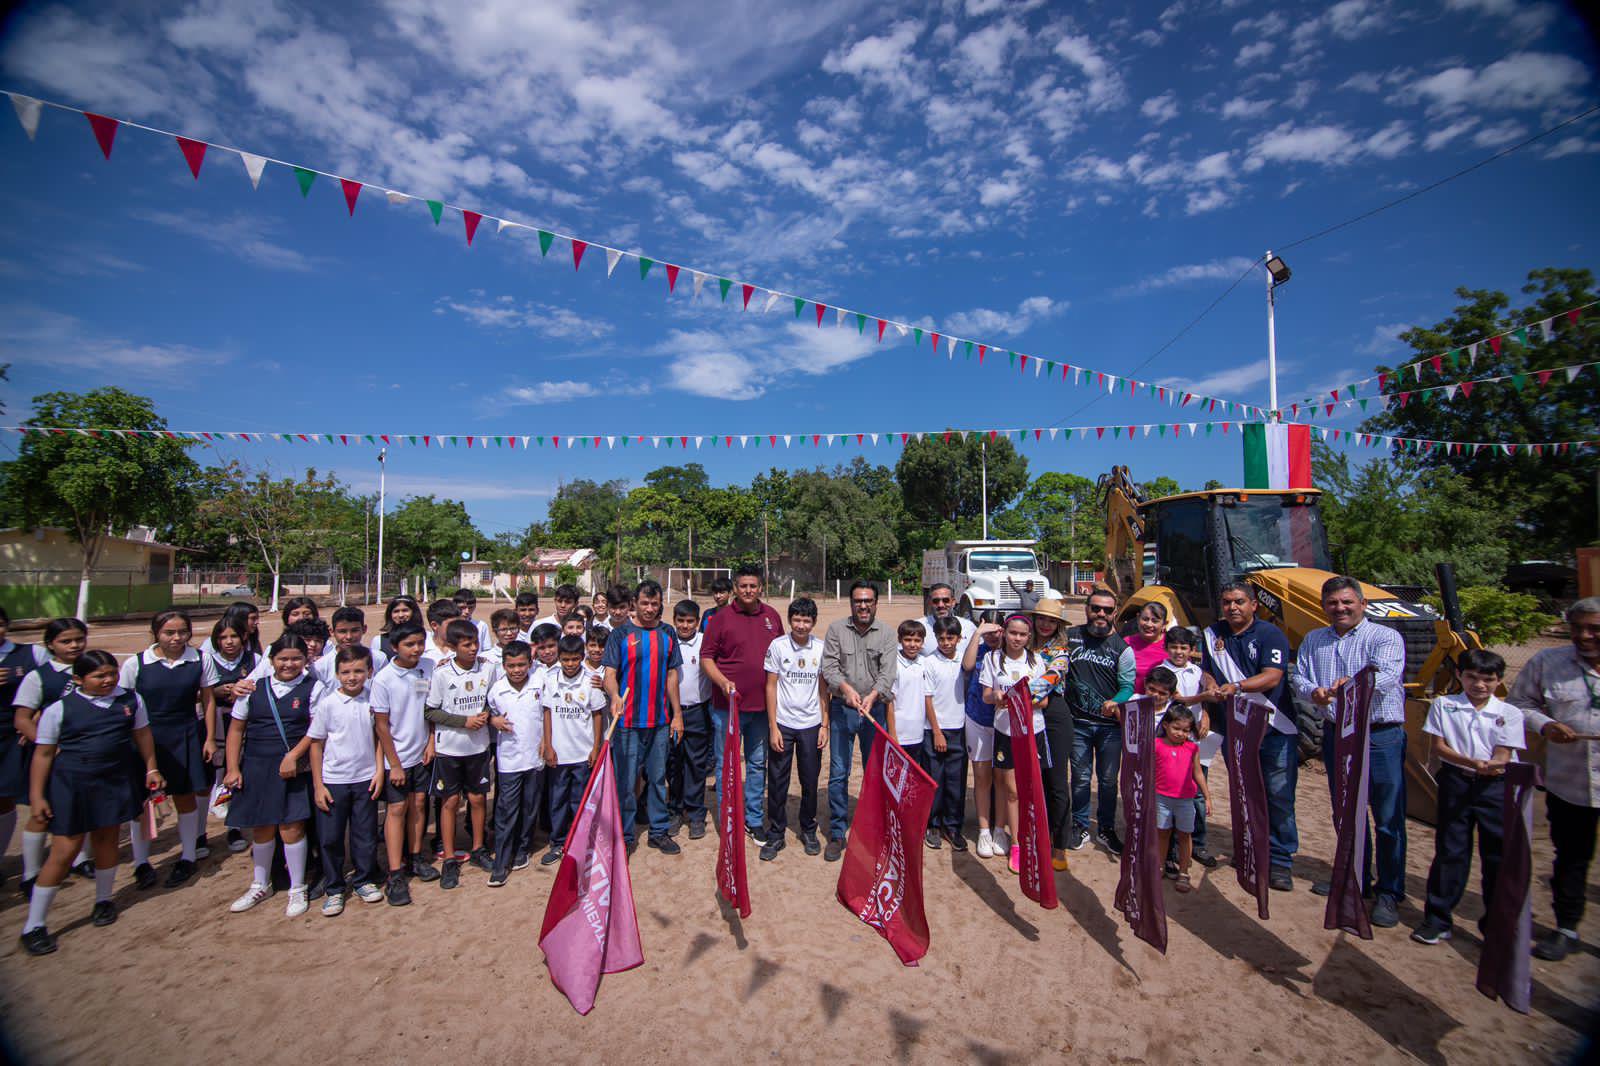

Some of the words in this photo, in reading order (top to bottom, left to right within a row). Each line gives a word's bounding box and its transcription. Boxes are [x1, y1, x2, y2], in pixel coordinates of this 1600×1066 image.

[1364, 602, 1421, 617] CAT
[1271, 648, 1282, 664] 3
[786, 670, 817, 679] Emirates
[453, 694, 486, 705] Emirate
